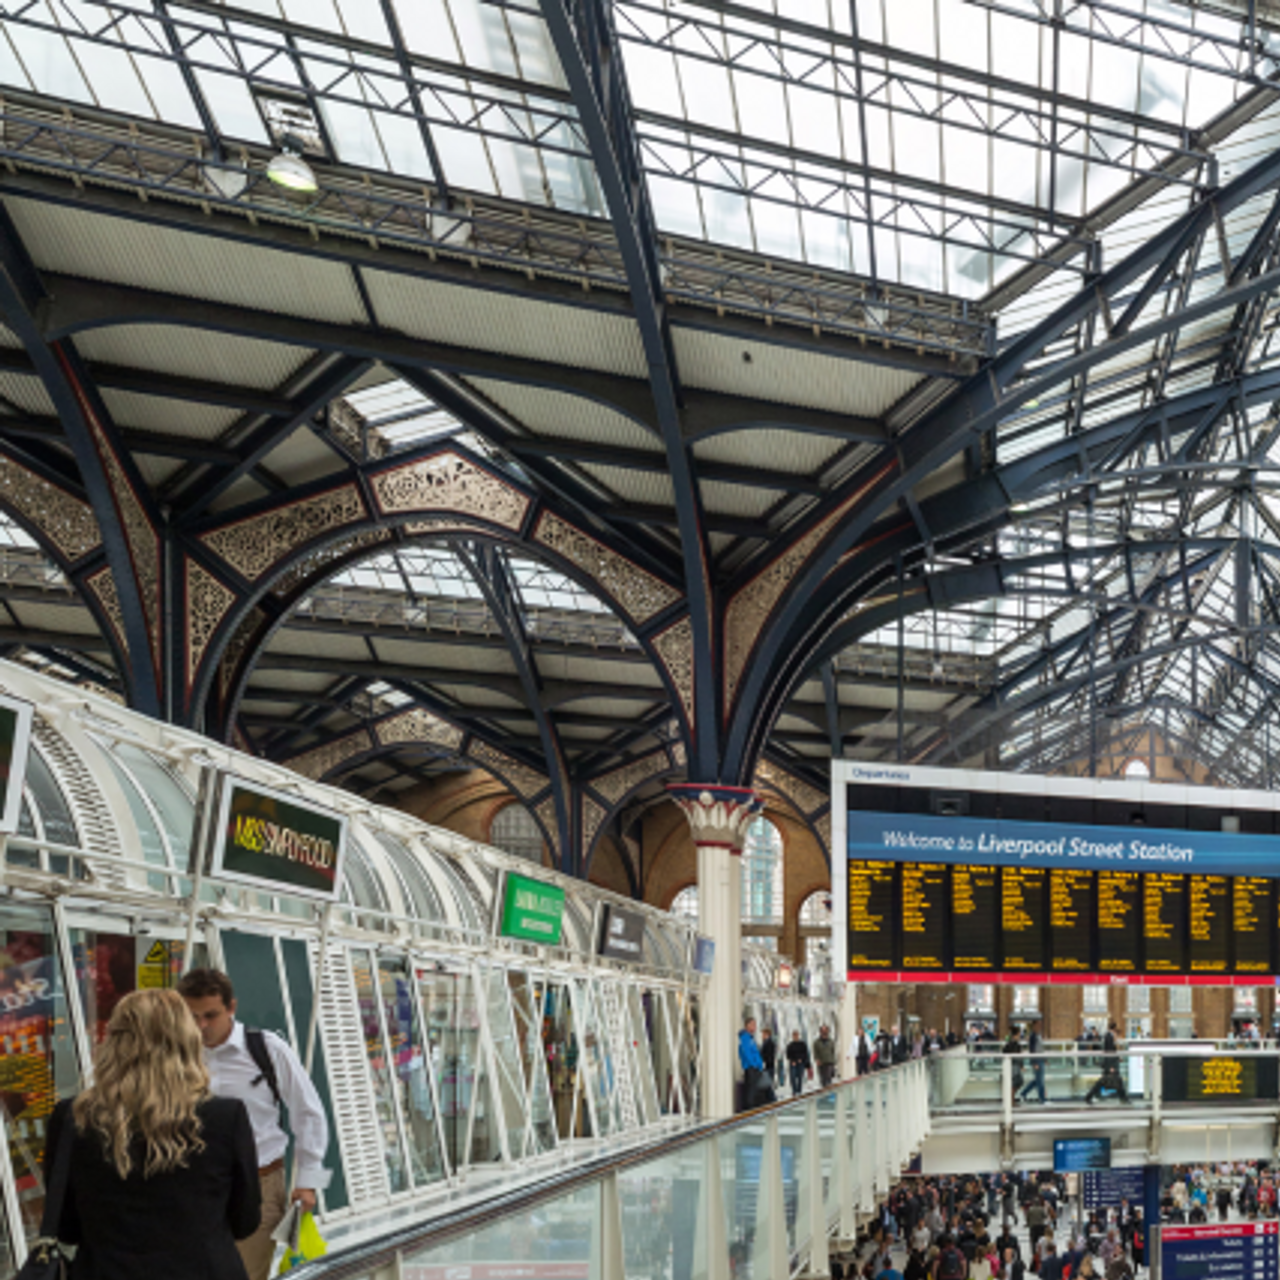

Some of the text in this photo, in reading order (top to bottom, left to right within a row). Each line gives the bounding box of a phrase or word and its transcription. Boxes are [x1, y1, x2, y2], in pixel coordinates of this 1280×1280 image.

[882, 830, 1195, 862] Welcome to Liverpool Street Station
